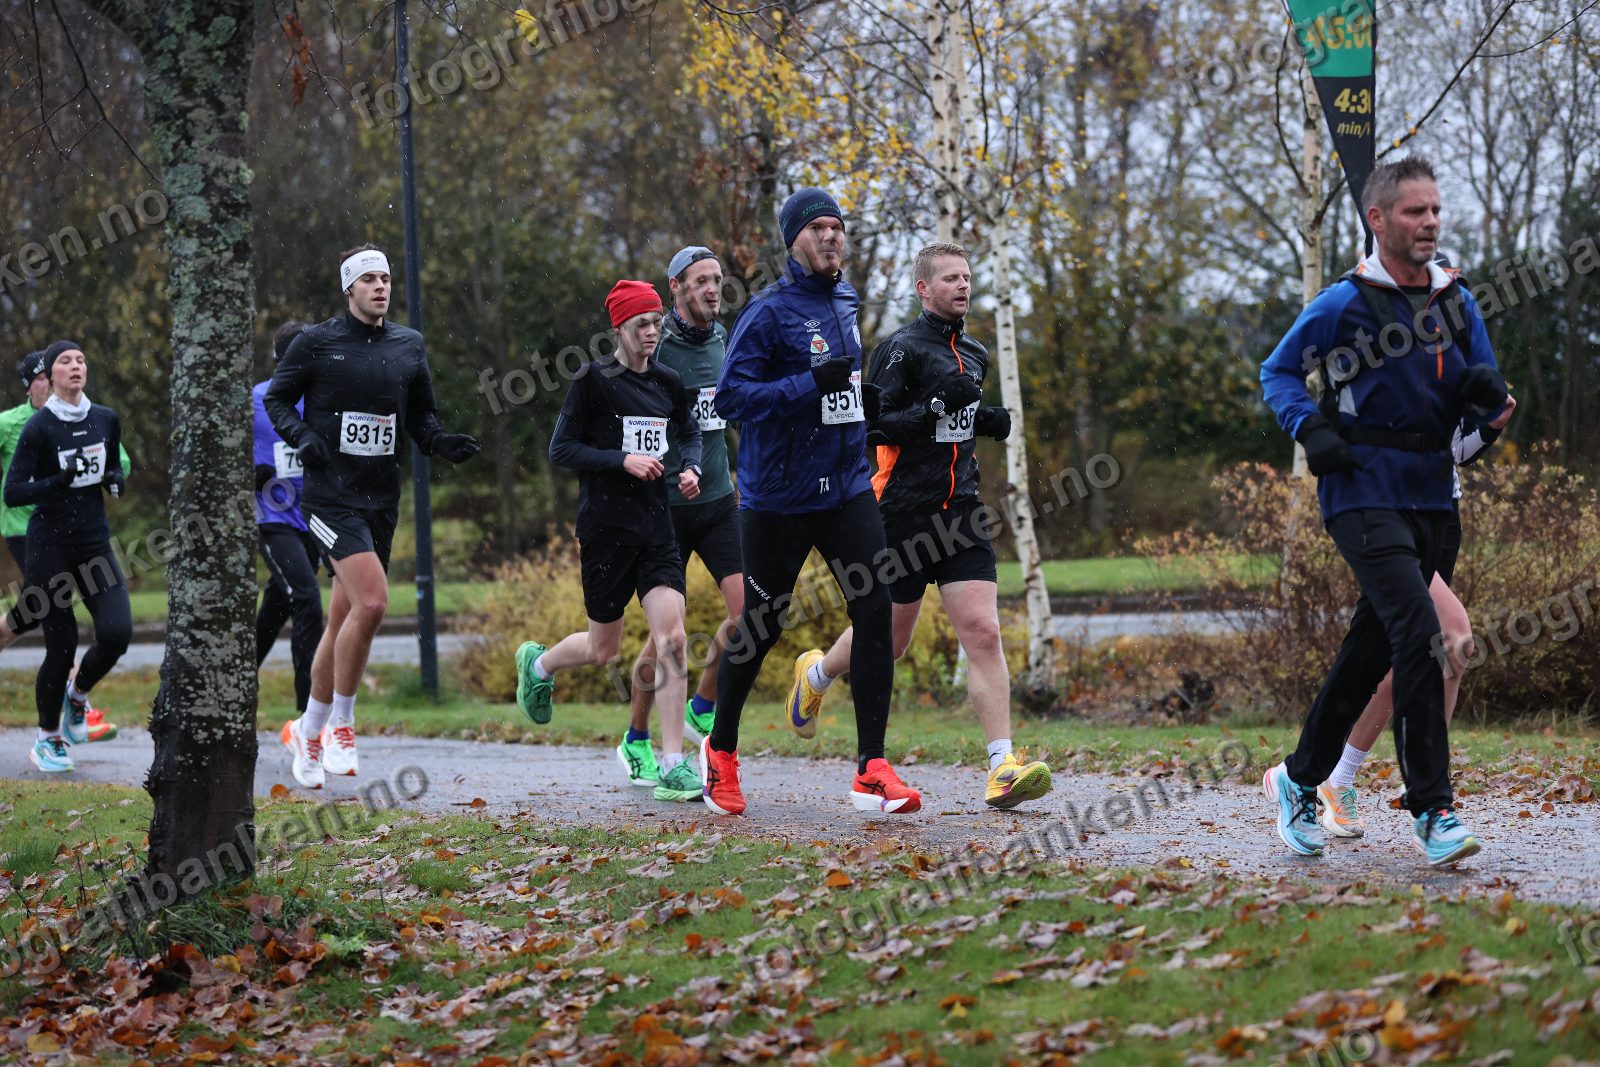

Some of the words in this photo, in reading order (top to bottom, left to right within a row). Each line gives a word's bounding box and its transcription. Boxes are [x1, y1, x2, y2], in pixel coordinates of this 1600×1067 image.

[346, 423, 393, 446] 9315
[634, 429, 661, 452] 165
[747, 575, 771, 601] TRIMTEX
